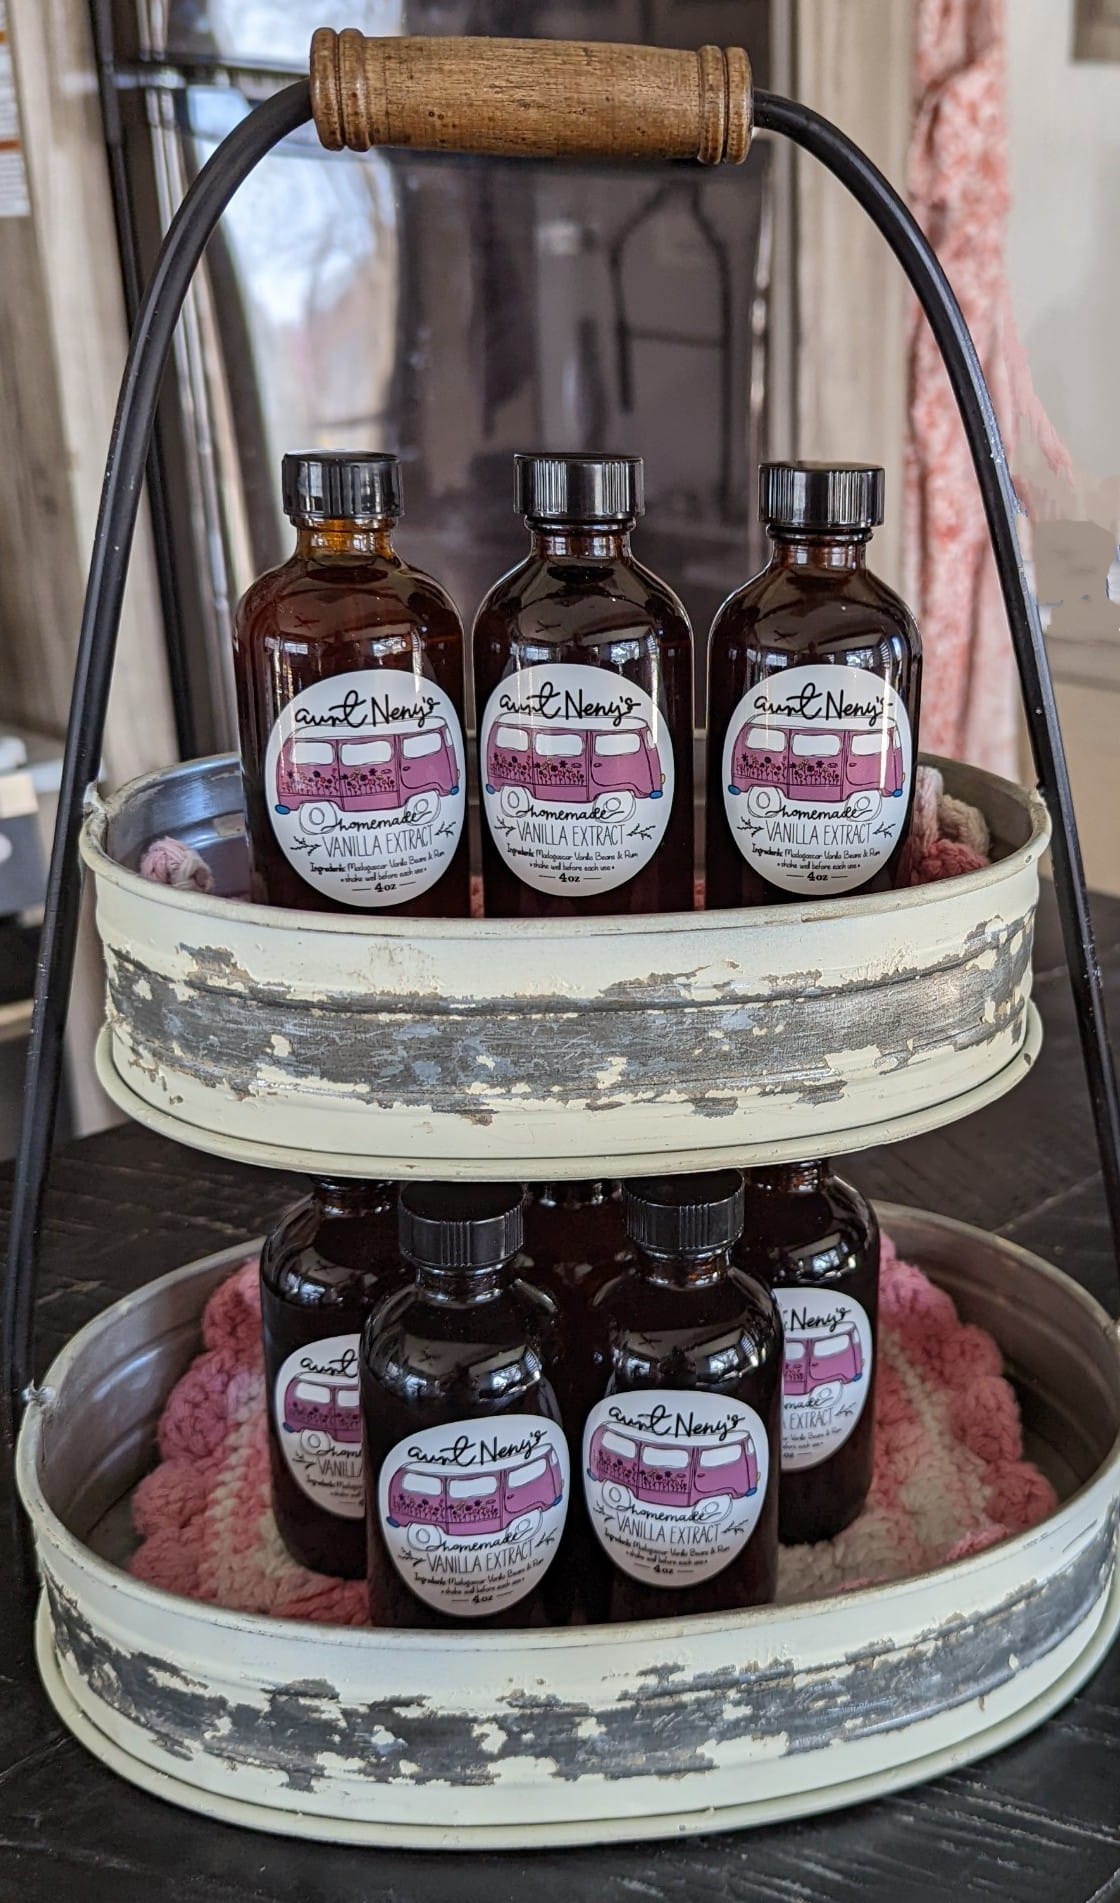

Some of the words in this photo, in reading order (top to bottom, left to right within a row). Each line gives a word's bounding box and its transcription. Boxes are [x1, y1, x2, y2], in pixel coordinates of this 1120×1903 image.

[295, 690, 368, 728] aunt
[371, 694, 441, 728] Neny's
[500, 682, 561, 719] aunt
[565, 689, 641, 727] Neny's
[754, 682, 823, 720] aunt
[320, 811, 432, 832] homemade
[515, 805, 624, 820] homemade
[765, 805, 872, 820] homemade
[322, 834, 382, 858] VANILLA
[386, 825, 433, 854] EXTRACT
[516, 820, 568, 846] VANILLA
[573, 824, 625, 847] EXTRACT
[765, 820, 819, 845] VANILLA
[824, 823, 873, 846] EXTRACT
[347, 862, 387, 873] Madagascar
[408, 855, 427, 865] Beans
[434, 849, 445, 858] Rum
[533, 860, 549, 869] shake
[550, 862, 561, 870] well
[563, 862, 582, 871] before
[584, 863, 599, 871] each
[535, 849, 573, 862] Madagascar
[595, 852, 615, 861] Beans
[624, 850, 638, 858] Rum
[781, 859, 798, 869] shake
[799, 861, 811, 869] well
[812, 861, 831, 870] before
[832, 861, 846, 870] each
[784, 849, 822, 861] Madagascar
[843, 850, 861, 858] Beans
[869, 848, 880, 857] Rum
[345, 874, 362, 883] shake
[365, 873, 377, 882] well
[378, 871, 398, 880] before
[400, 867, 413, 877] each
[790, 1307, 851, 1333] Neny's
[300, 1349, 358, 1379] aunt
[608, 1404, 672, 1436] aunt
[675, 1412, 745, 1441] Neny's
[790, 1408, 832, 1430] EXTRACT
[408, 1435, 476, 1467] aunt
[480, 1430, 548, 1466] Neny's
[616, 1503, 721, 1521] homemade
[426, 1526, 533, 1553] homemade
[616, 1512, 666, 1543] VANILLA
[670, 1523, 721, 1545] EXTRACT
[426, 1552, 482, 1574] VANILLA
[486, 1539, 534, 1571] EXTRACT
